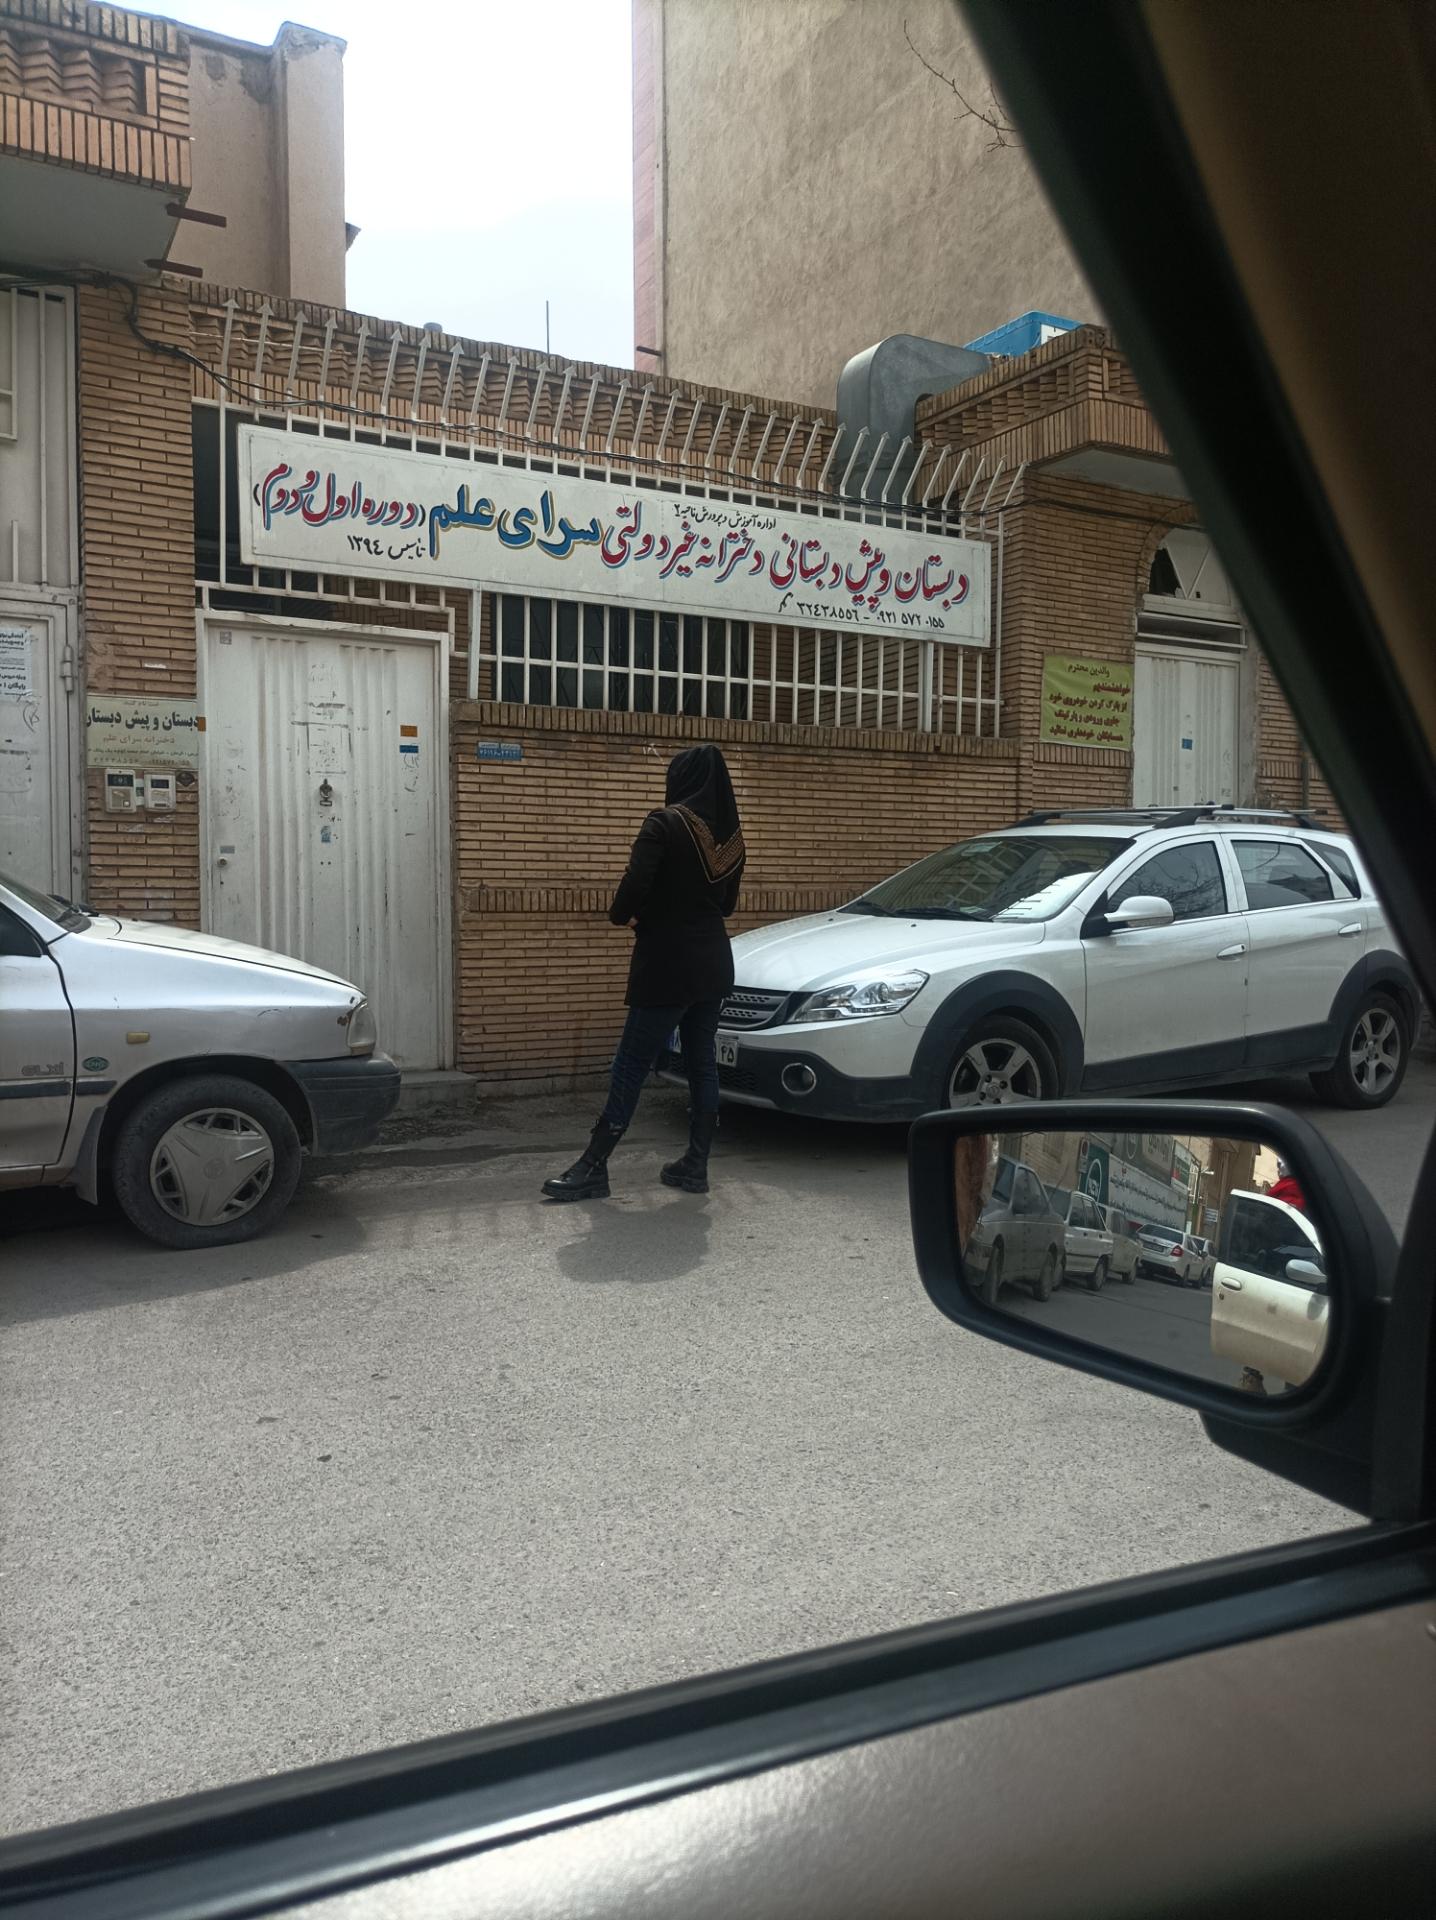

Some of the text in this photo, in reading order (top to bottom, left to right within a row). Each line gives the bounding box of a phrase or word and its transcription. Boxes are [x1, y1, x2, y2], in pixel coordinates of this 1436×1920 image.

[301, 472, 361, 527] اول
[429, 484, 495, 560] علم
[497, 489, 603, 560] سرای
[695, 506, 723, 527] پرورش
[728, 510, 759, 528] آموزش
[757, 517, 776, 530] اداره
[695, 528, 764, 582] دخترانه
[770, 533, 842, 590] دبستانی
[845, 539, 887, 612] پیش
[872, 567, 891, 595] و
[895, 554, 969, 610] دبستان
[125, 709, 150, 731] پیش
[151, 716, 159, 731] و
